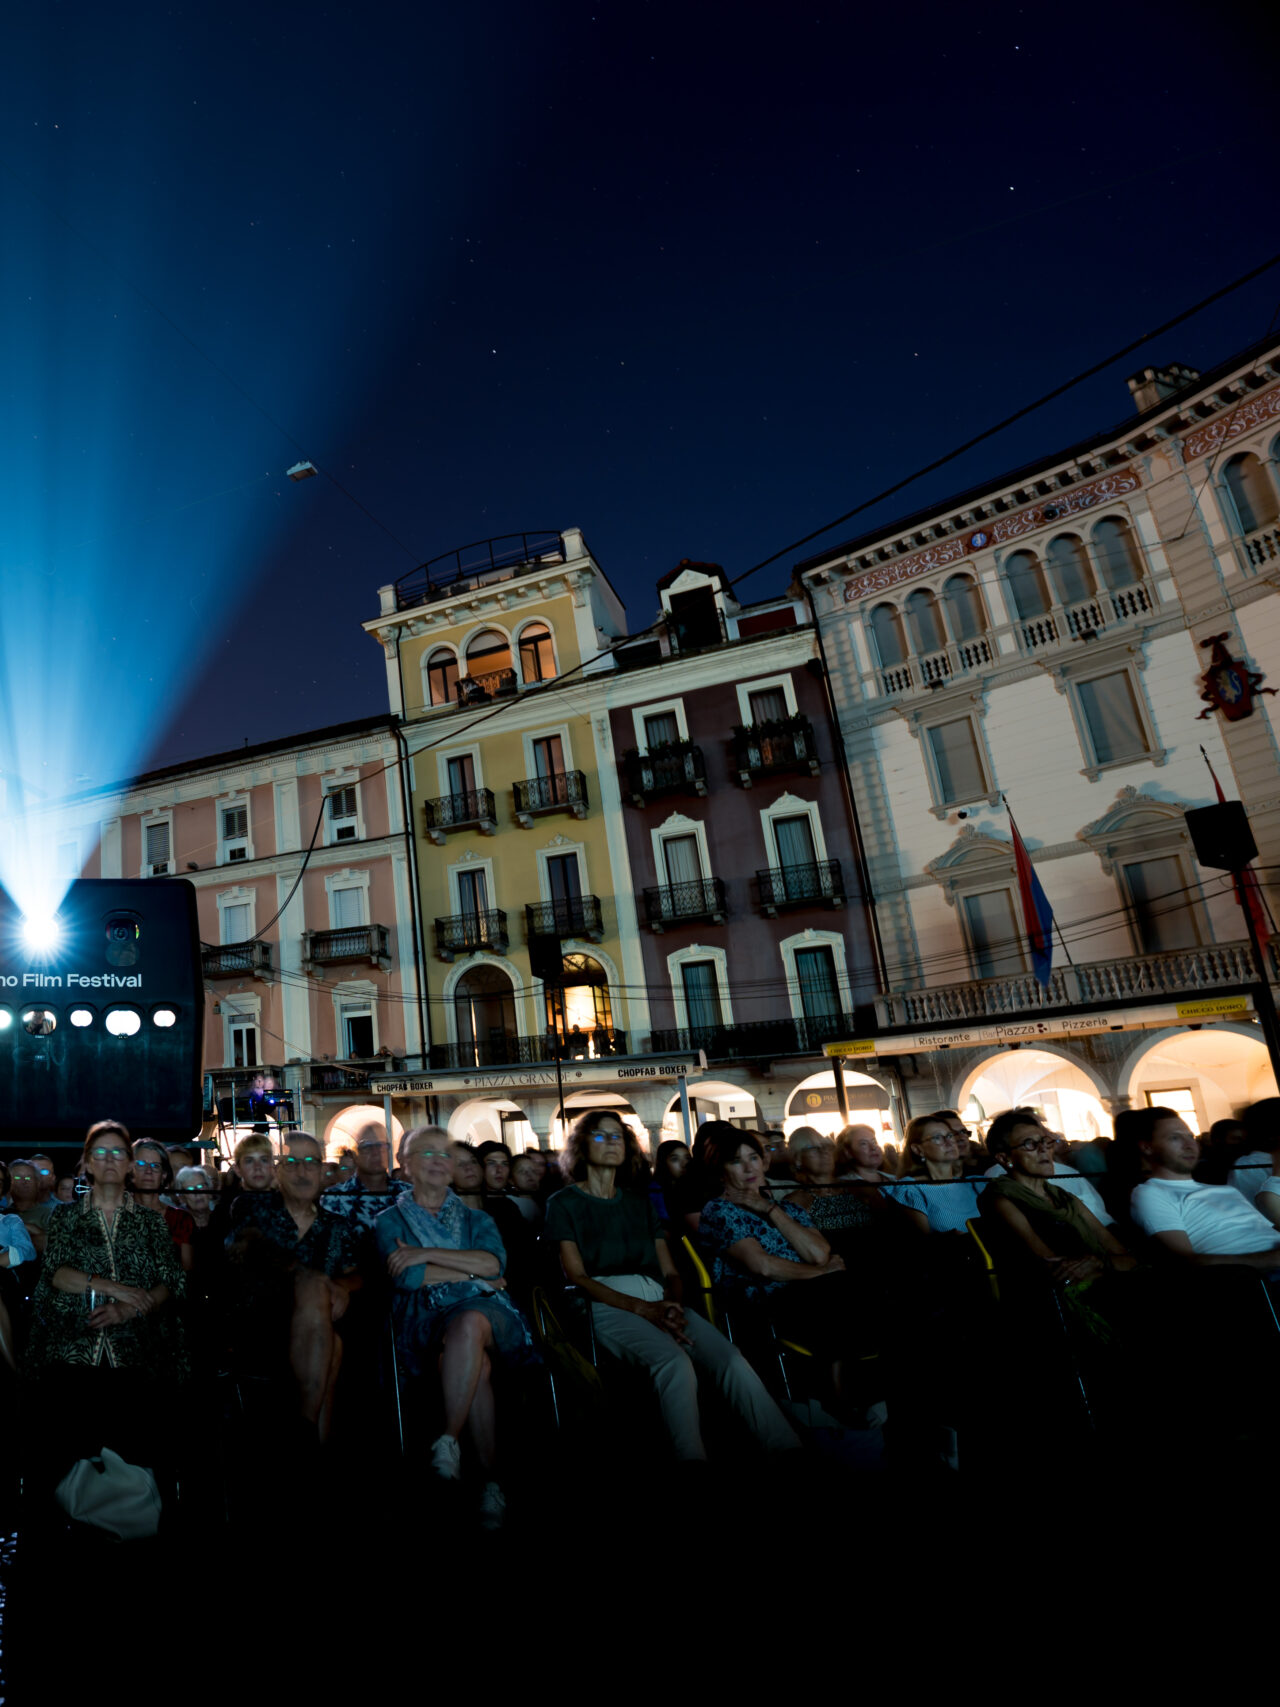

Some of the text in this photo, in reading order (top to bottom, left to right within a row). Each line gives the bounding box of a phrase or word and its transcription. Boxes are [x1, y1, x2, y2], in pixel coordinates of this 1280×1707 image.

[23, 973, 62, 988] Film
[67, 973, 142, 988] Festival
[1062, 1017, 1108, 1030] Pizzeria
[995, 1025, 1035, 1037] Piazza
[919, 1033, 970, 1045] Ristorante
[618, 1065, 687, 1077] CHOPFAB BOXER
[376, 1081, 434, 1092] CHOPFAB BOXER
[474, 1075, 516, 1087] PIAZZA
